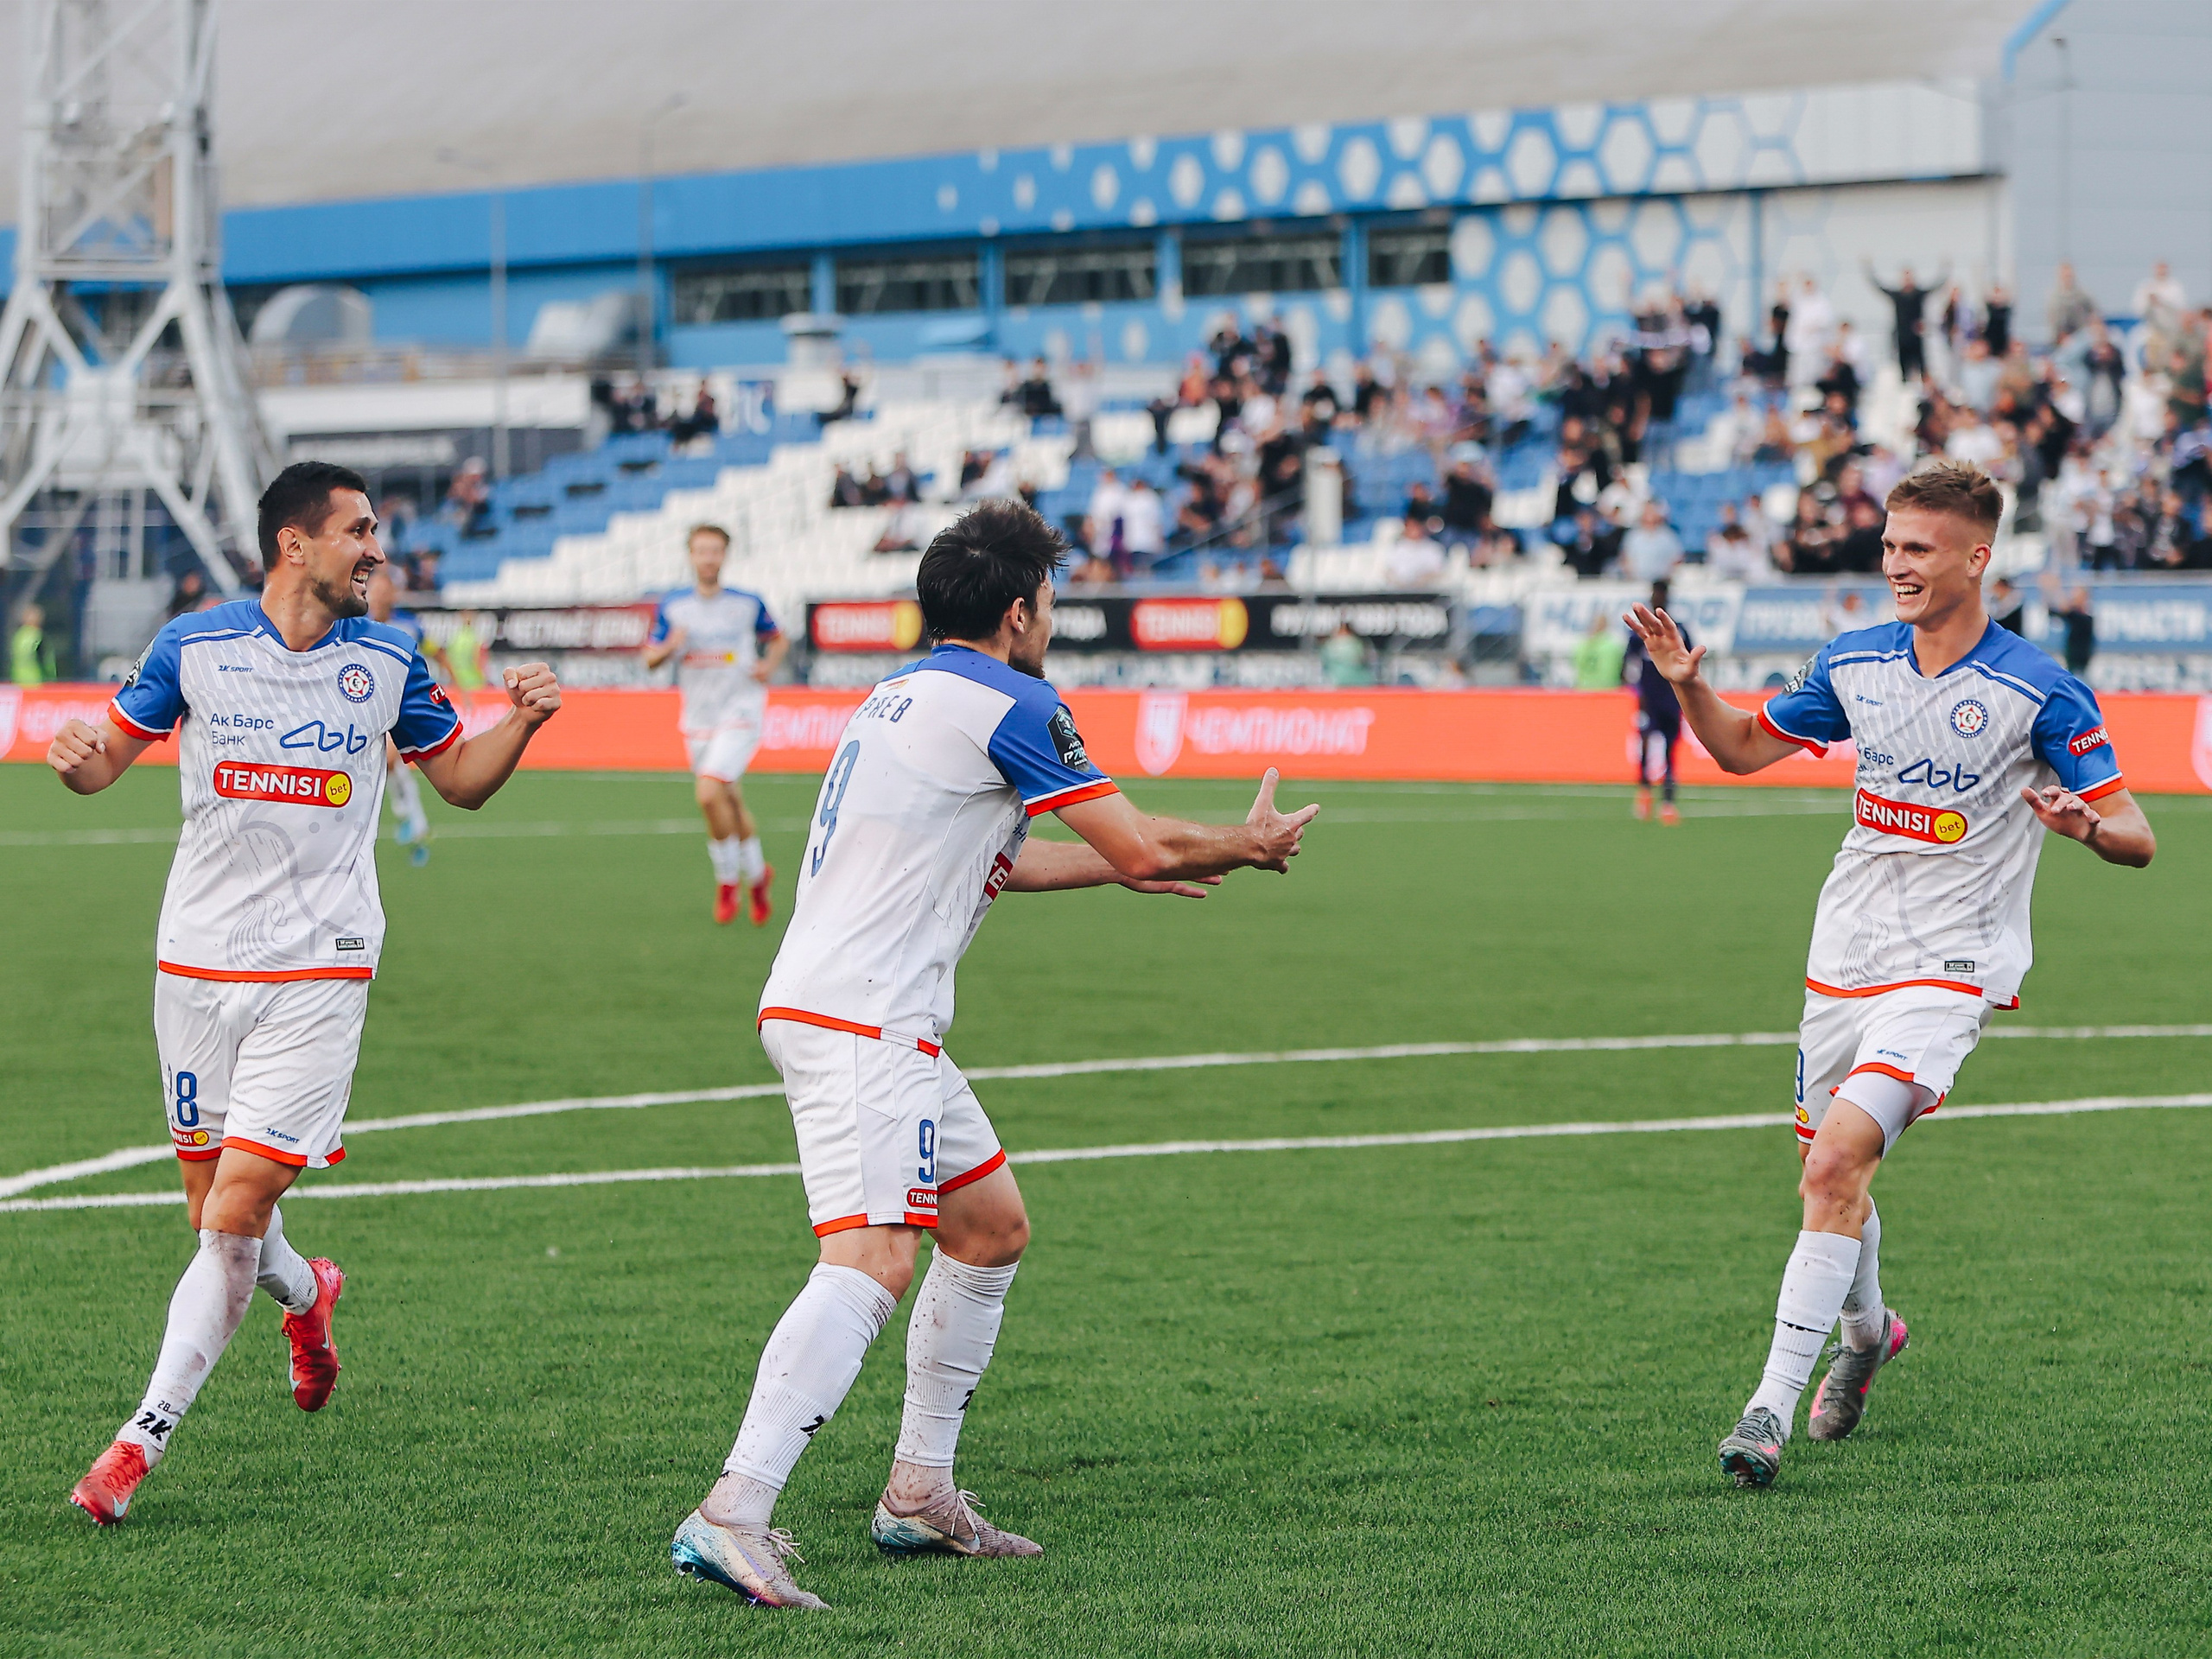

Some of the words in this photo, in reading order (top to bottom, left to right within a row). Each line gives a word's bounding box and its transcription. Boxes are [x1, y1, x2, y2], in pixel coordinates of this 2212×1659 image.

[210, 713, 229, 727] Ак
[233, 714, 274, 731] Барс
[1186, 706, 1375, 754] ЧЕМПИОНАТ
[212, 731, 245, 746] Банк
[219, 767, 321, 798] TENNISI
[329, 781, 347, 796] bet
[810, 740, 861, 878] 9
[1858, 793, 1931, 835] TENNISI
[1938, 821, 1961, 834] bet
[168, 1064, 200, 1127] 8
[277, 1133, 300, 1144] SPORT
[918, 1118, 935, 1184] 9
[910, 1192, 938, 1205] TENN
[157, 1400, 171, 1412] 28
[136, 1411, 173, 1442] 2K
